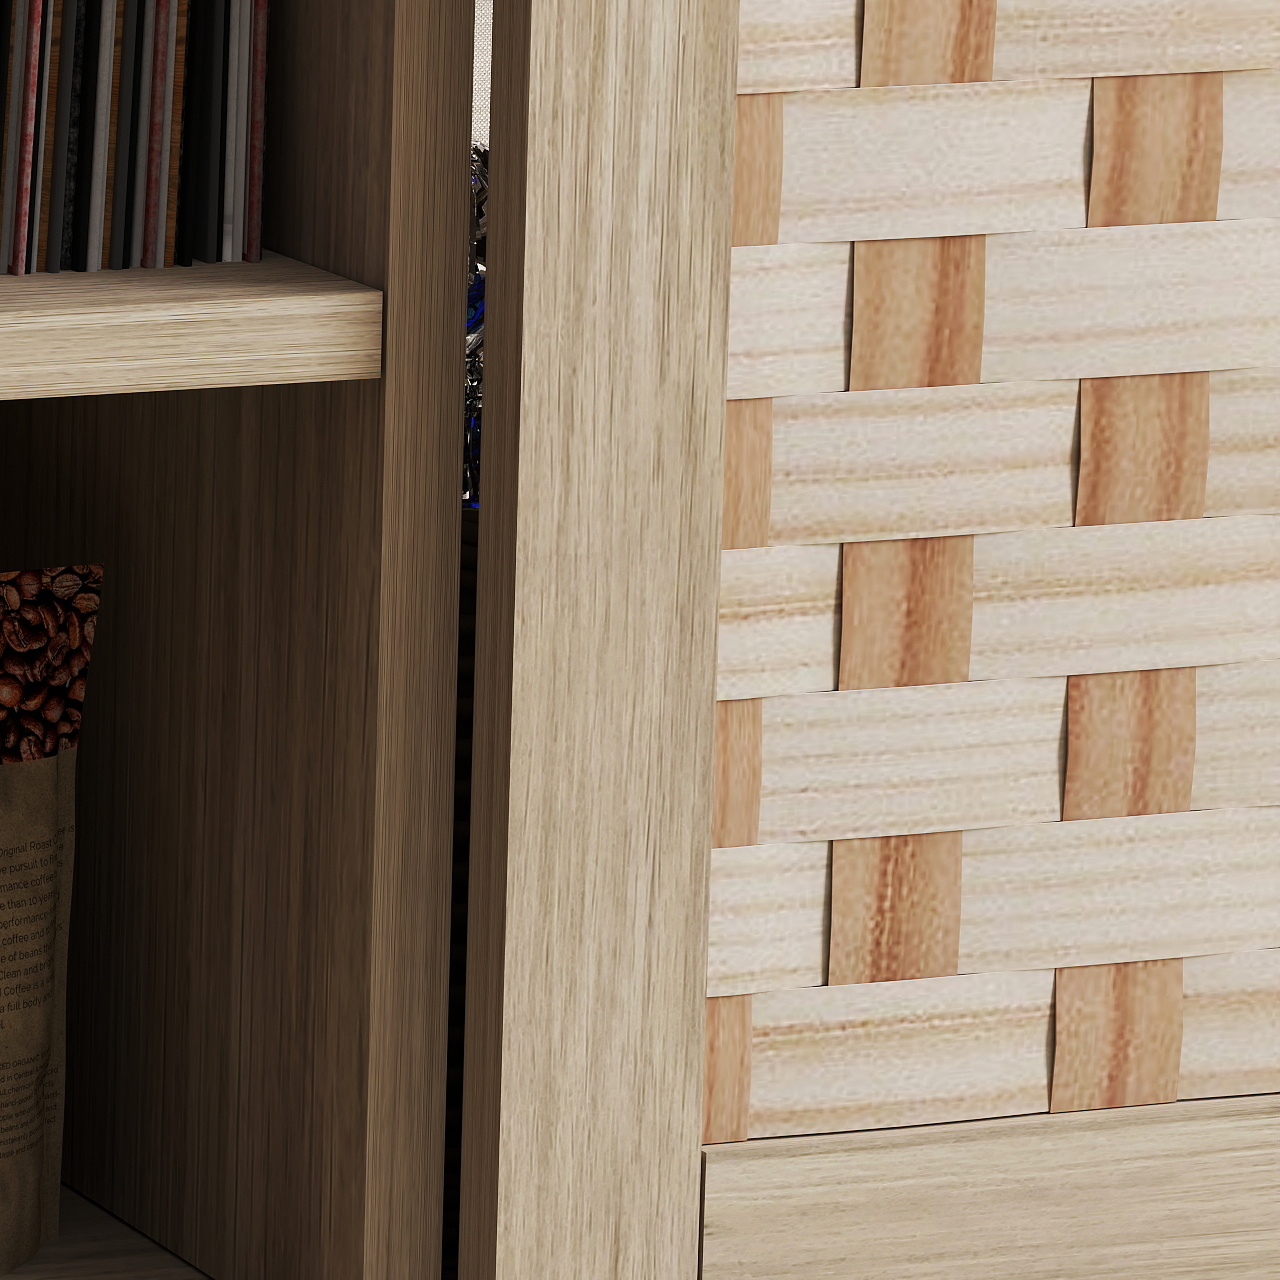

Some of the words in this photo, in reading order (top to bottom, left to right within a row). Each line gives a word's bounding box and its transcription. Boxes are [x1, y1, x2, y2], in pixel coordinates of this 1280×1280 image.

[29, 838, 52, 852] Roast
[9, 860, 38, 874] pursuit
[40, 858, 48, 867] to
[31, 875, 53, 887] coffee
[8, 899, 26, 910] than
[2, 935, 28, 947] coffee
[31, 931, 44, 941] and
[8, 953, 17, 962] of
[20, 948, 42, 960] beans
[24, 965, 37, 975] and
[4, 984, 31, 996] Coffee
[33, 981, 39, 989] is
[7, 1002, 20, 1011] full
[22, 997, 41, 1009] body
